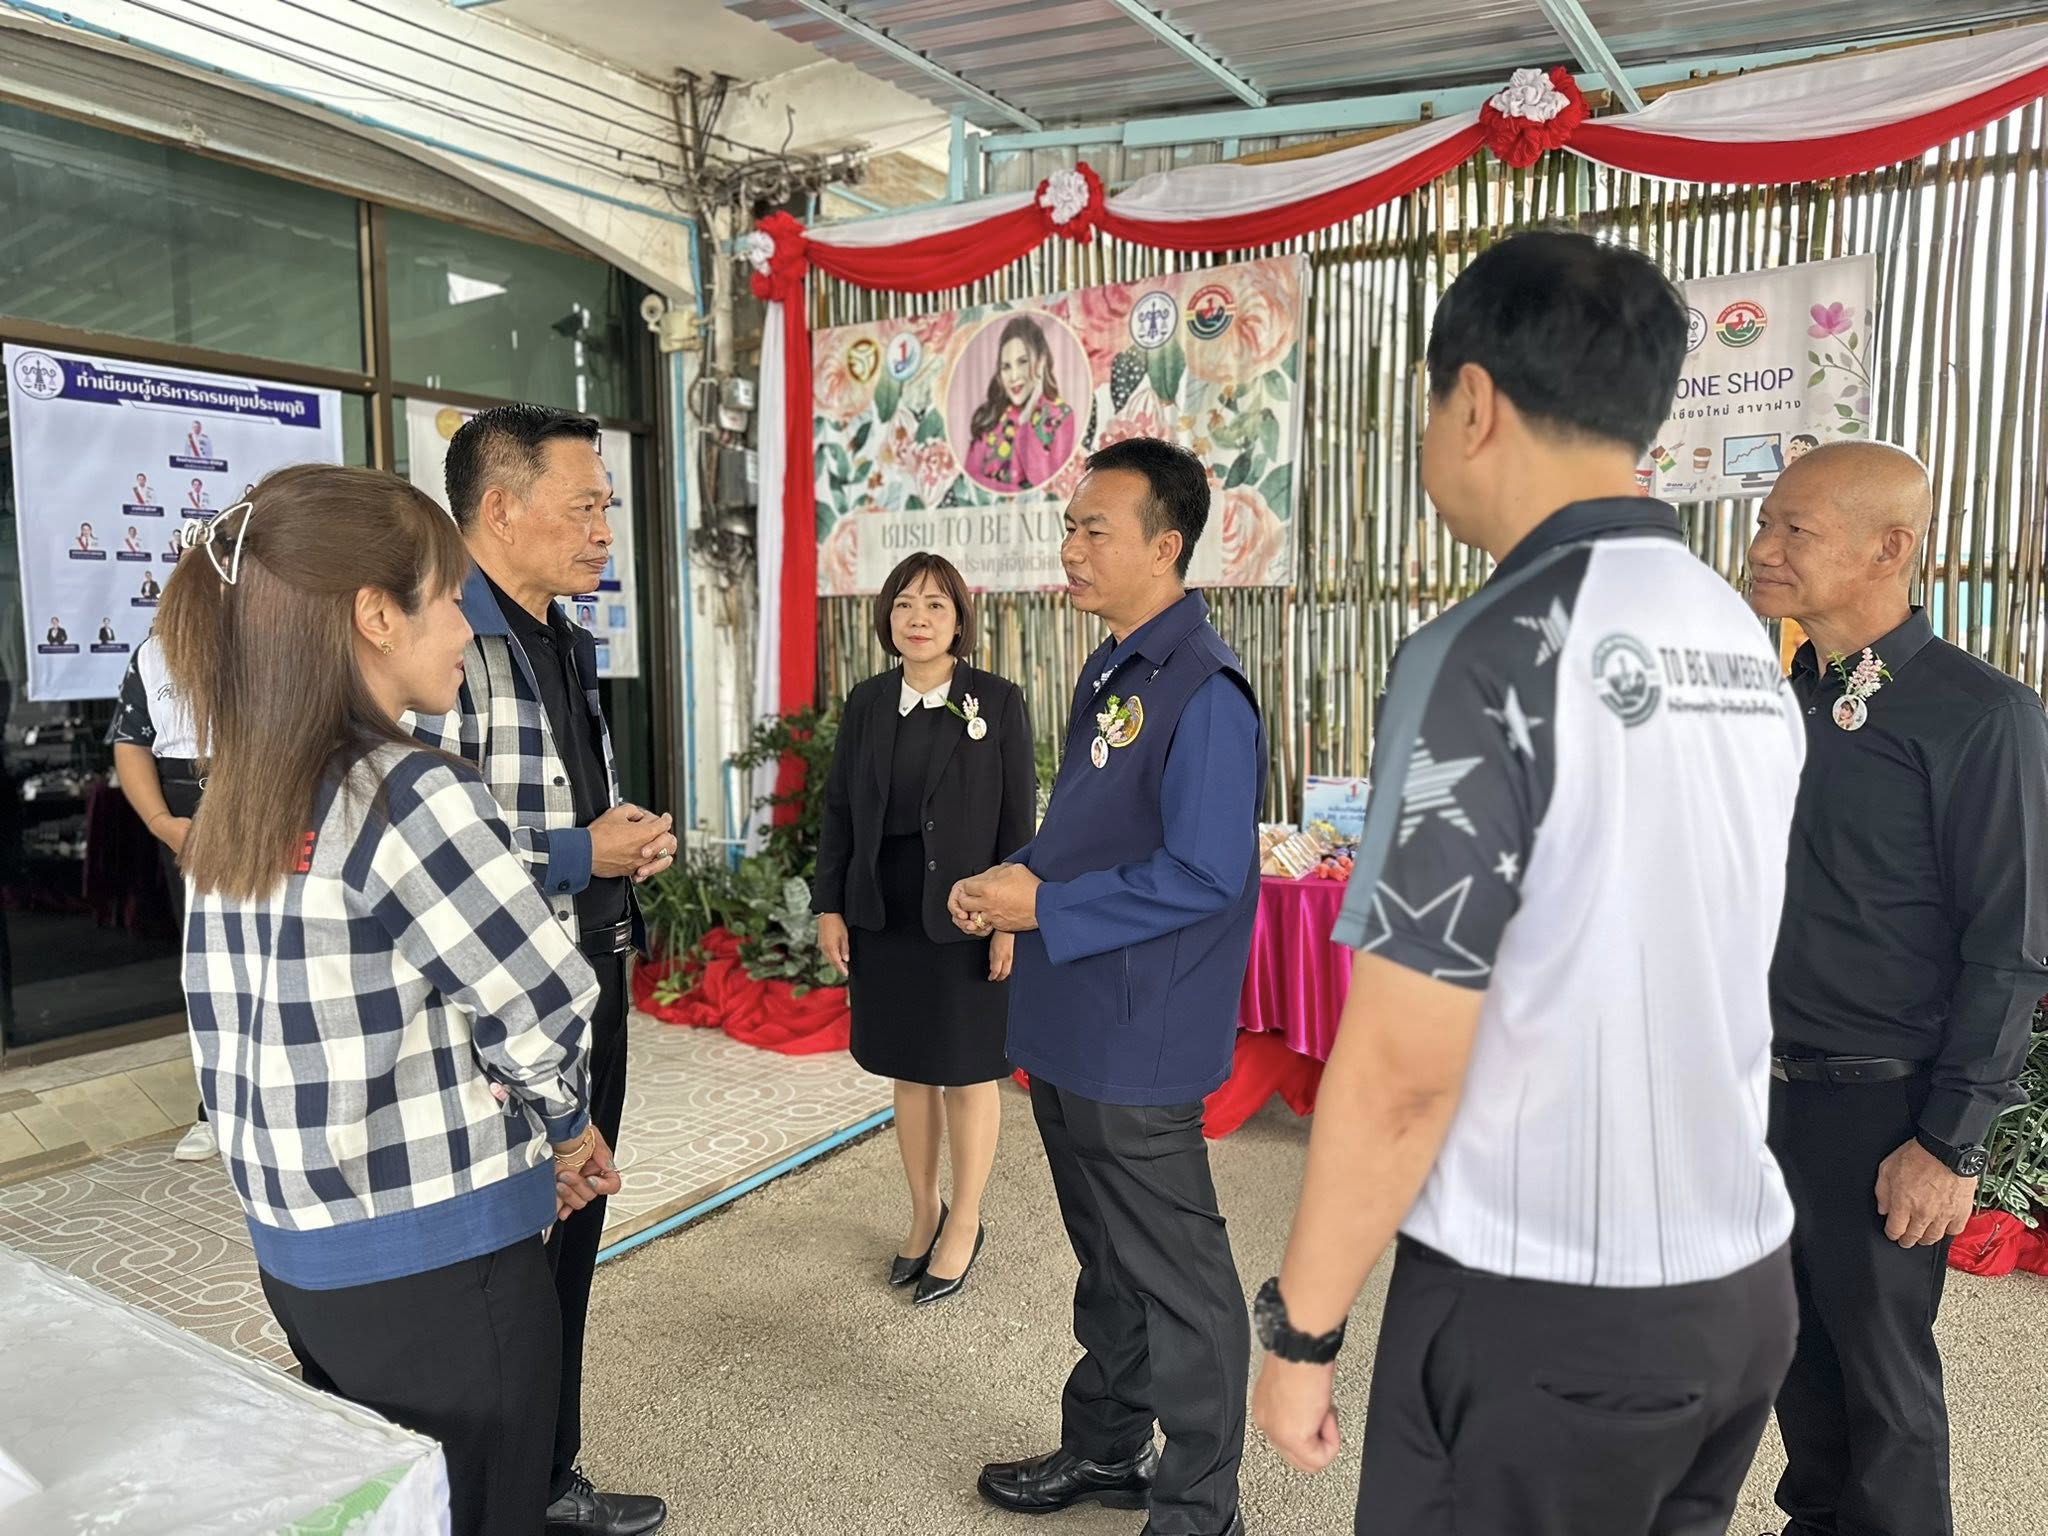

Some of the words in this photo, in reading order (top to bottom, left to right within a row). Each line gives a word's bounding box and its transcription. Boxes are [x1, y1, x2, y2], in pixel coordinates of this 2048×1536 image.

[76, 371, 305, 417] ทำเนียบผู้บริหารกรมคุมประพฤติ
[1676, 375, 1721, 400] ONE
[1727, 367, 1794, 394] SHOP
[881, 521, 936, 550] ชมรม
[942, 514, 973, 548] TO
[980, 512, 1011, 546] BE
[1658, 647, 1685, 687] TO
[1684, 648, 1709, 688] BE
